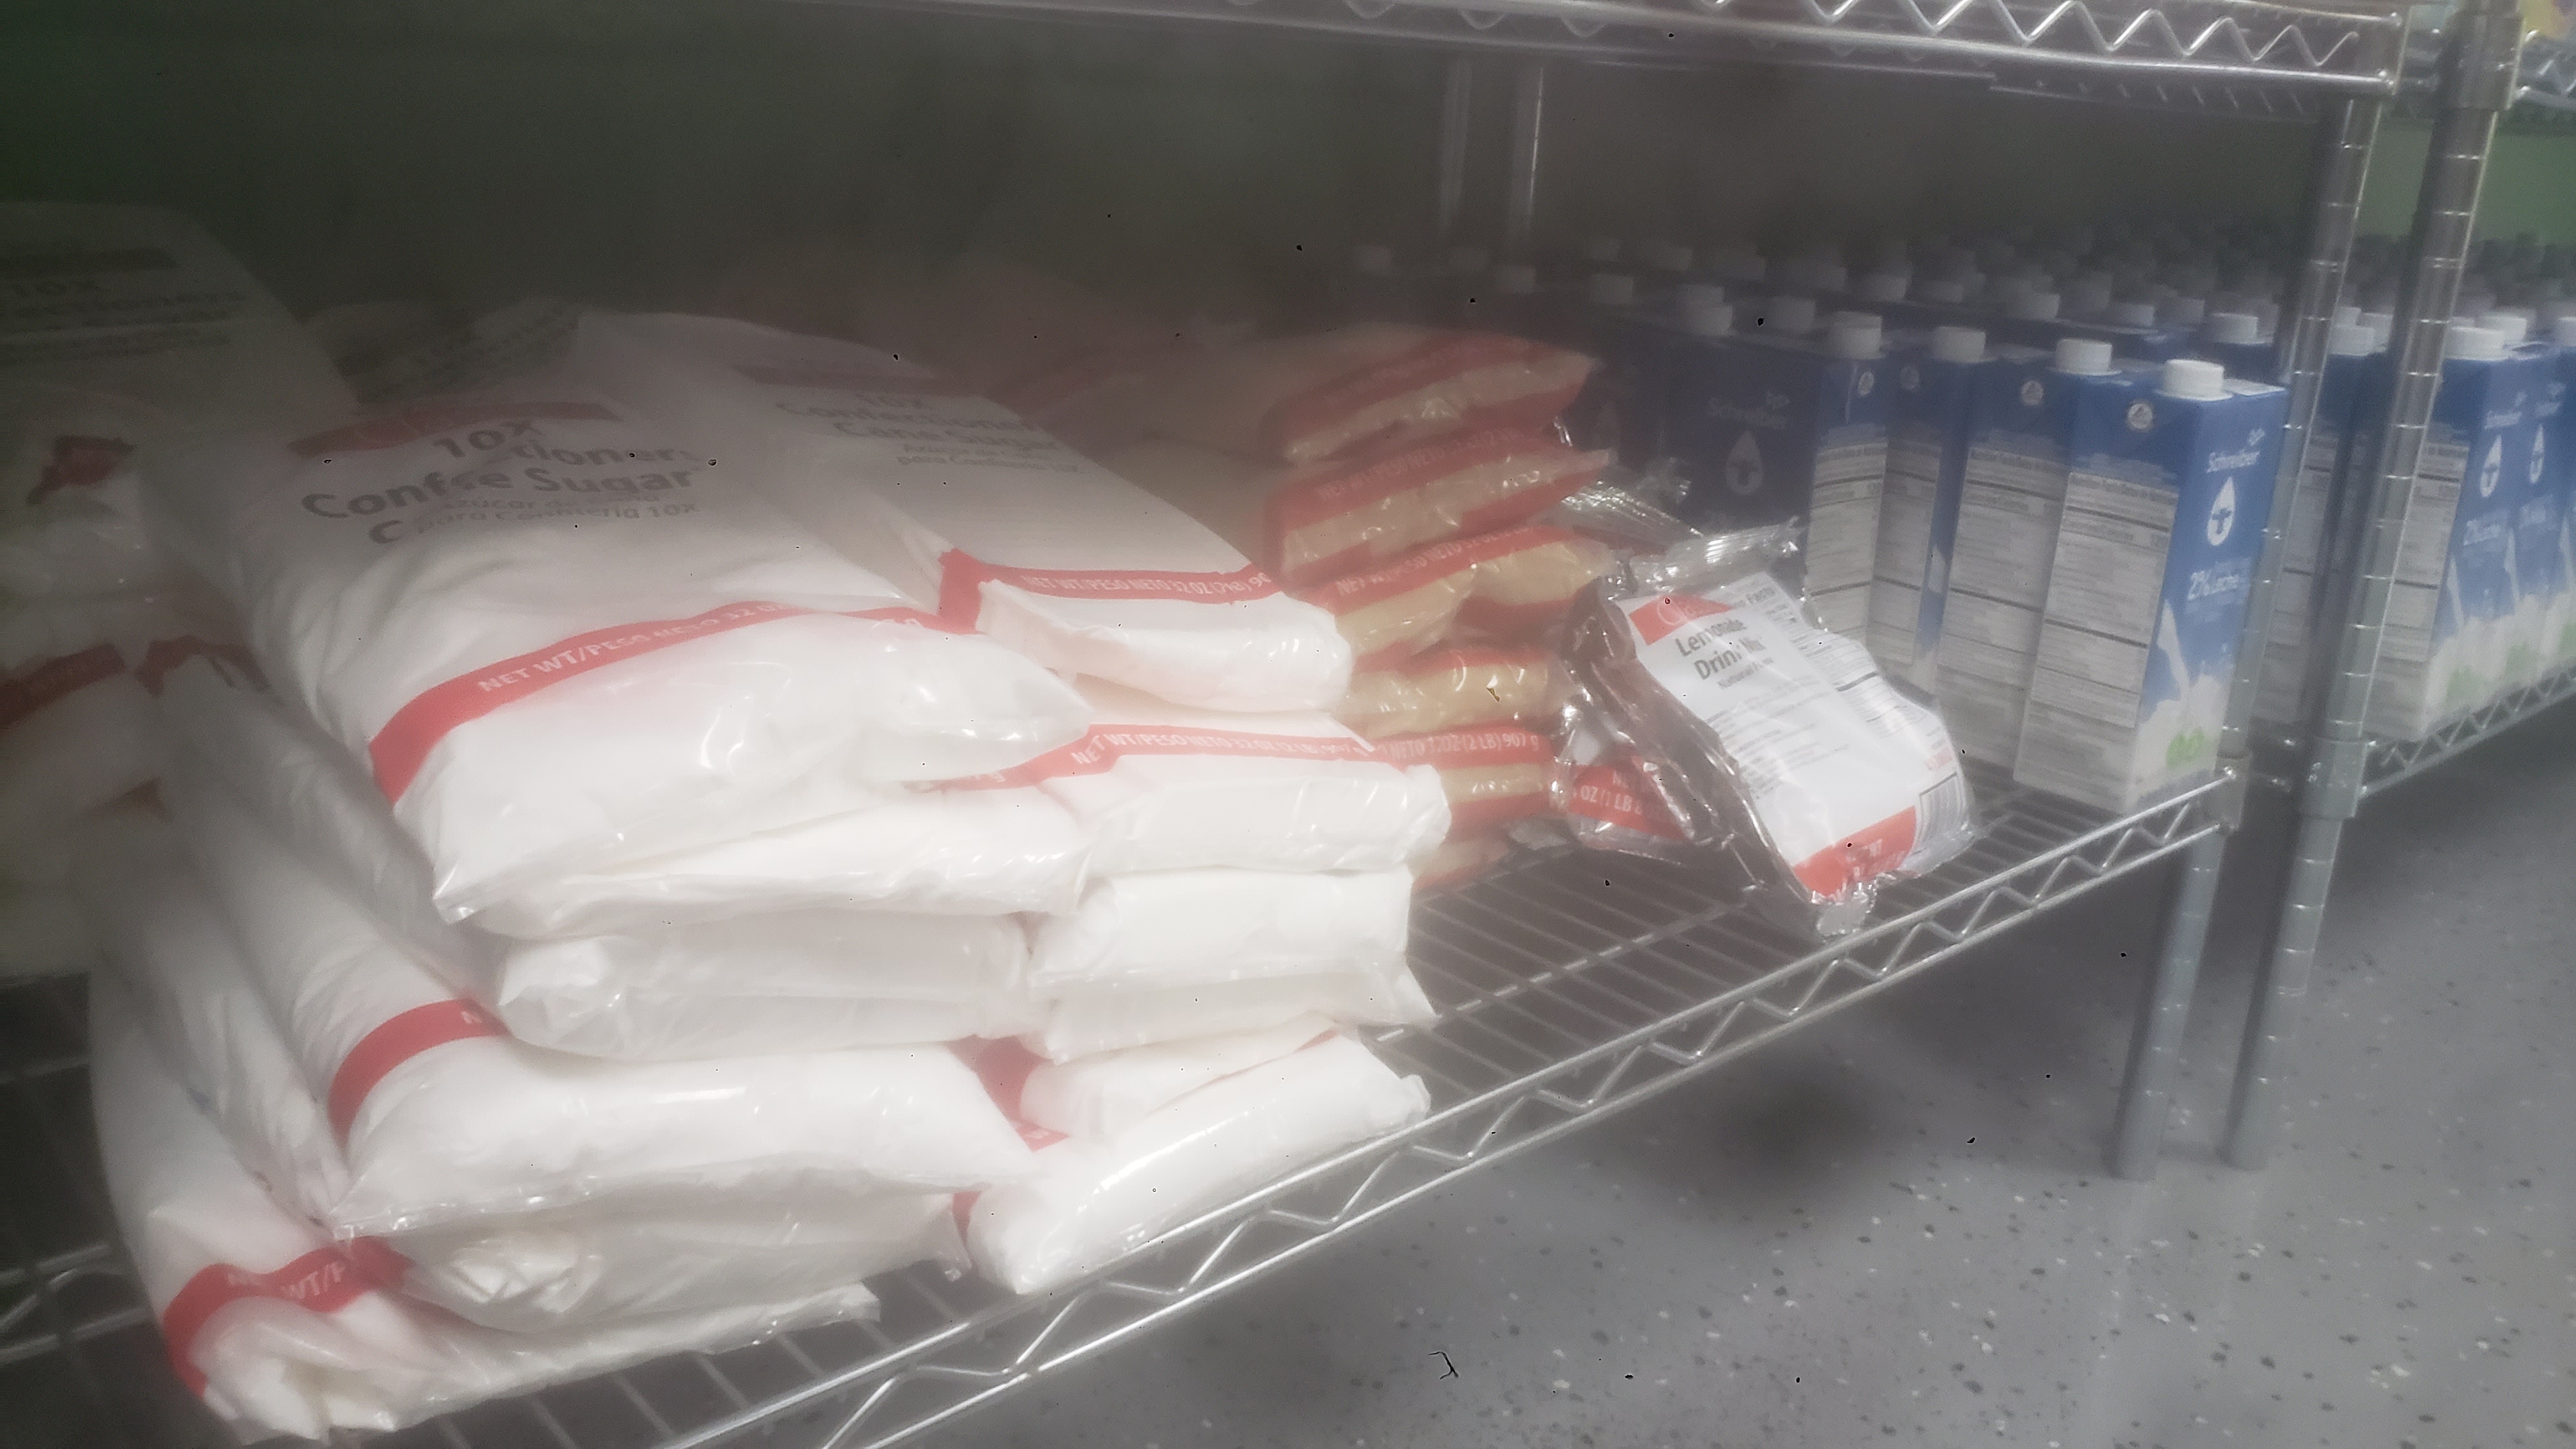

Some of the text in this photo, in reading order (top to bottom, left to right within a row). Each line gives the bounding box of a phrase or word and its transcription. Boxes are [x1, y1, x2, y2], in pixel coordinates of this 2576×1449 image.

[479, 668, 530, 692] NET
[1070, 735, 1105, 765] NET
[1502, 732, 1527, 747] 907
[1580, 785, 1598, 803] OZ
[1614, 793, 1633, 813] LB
